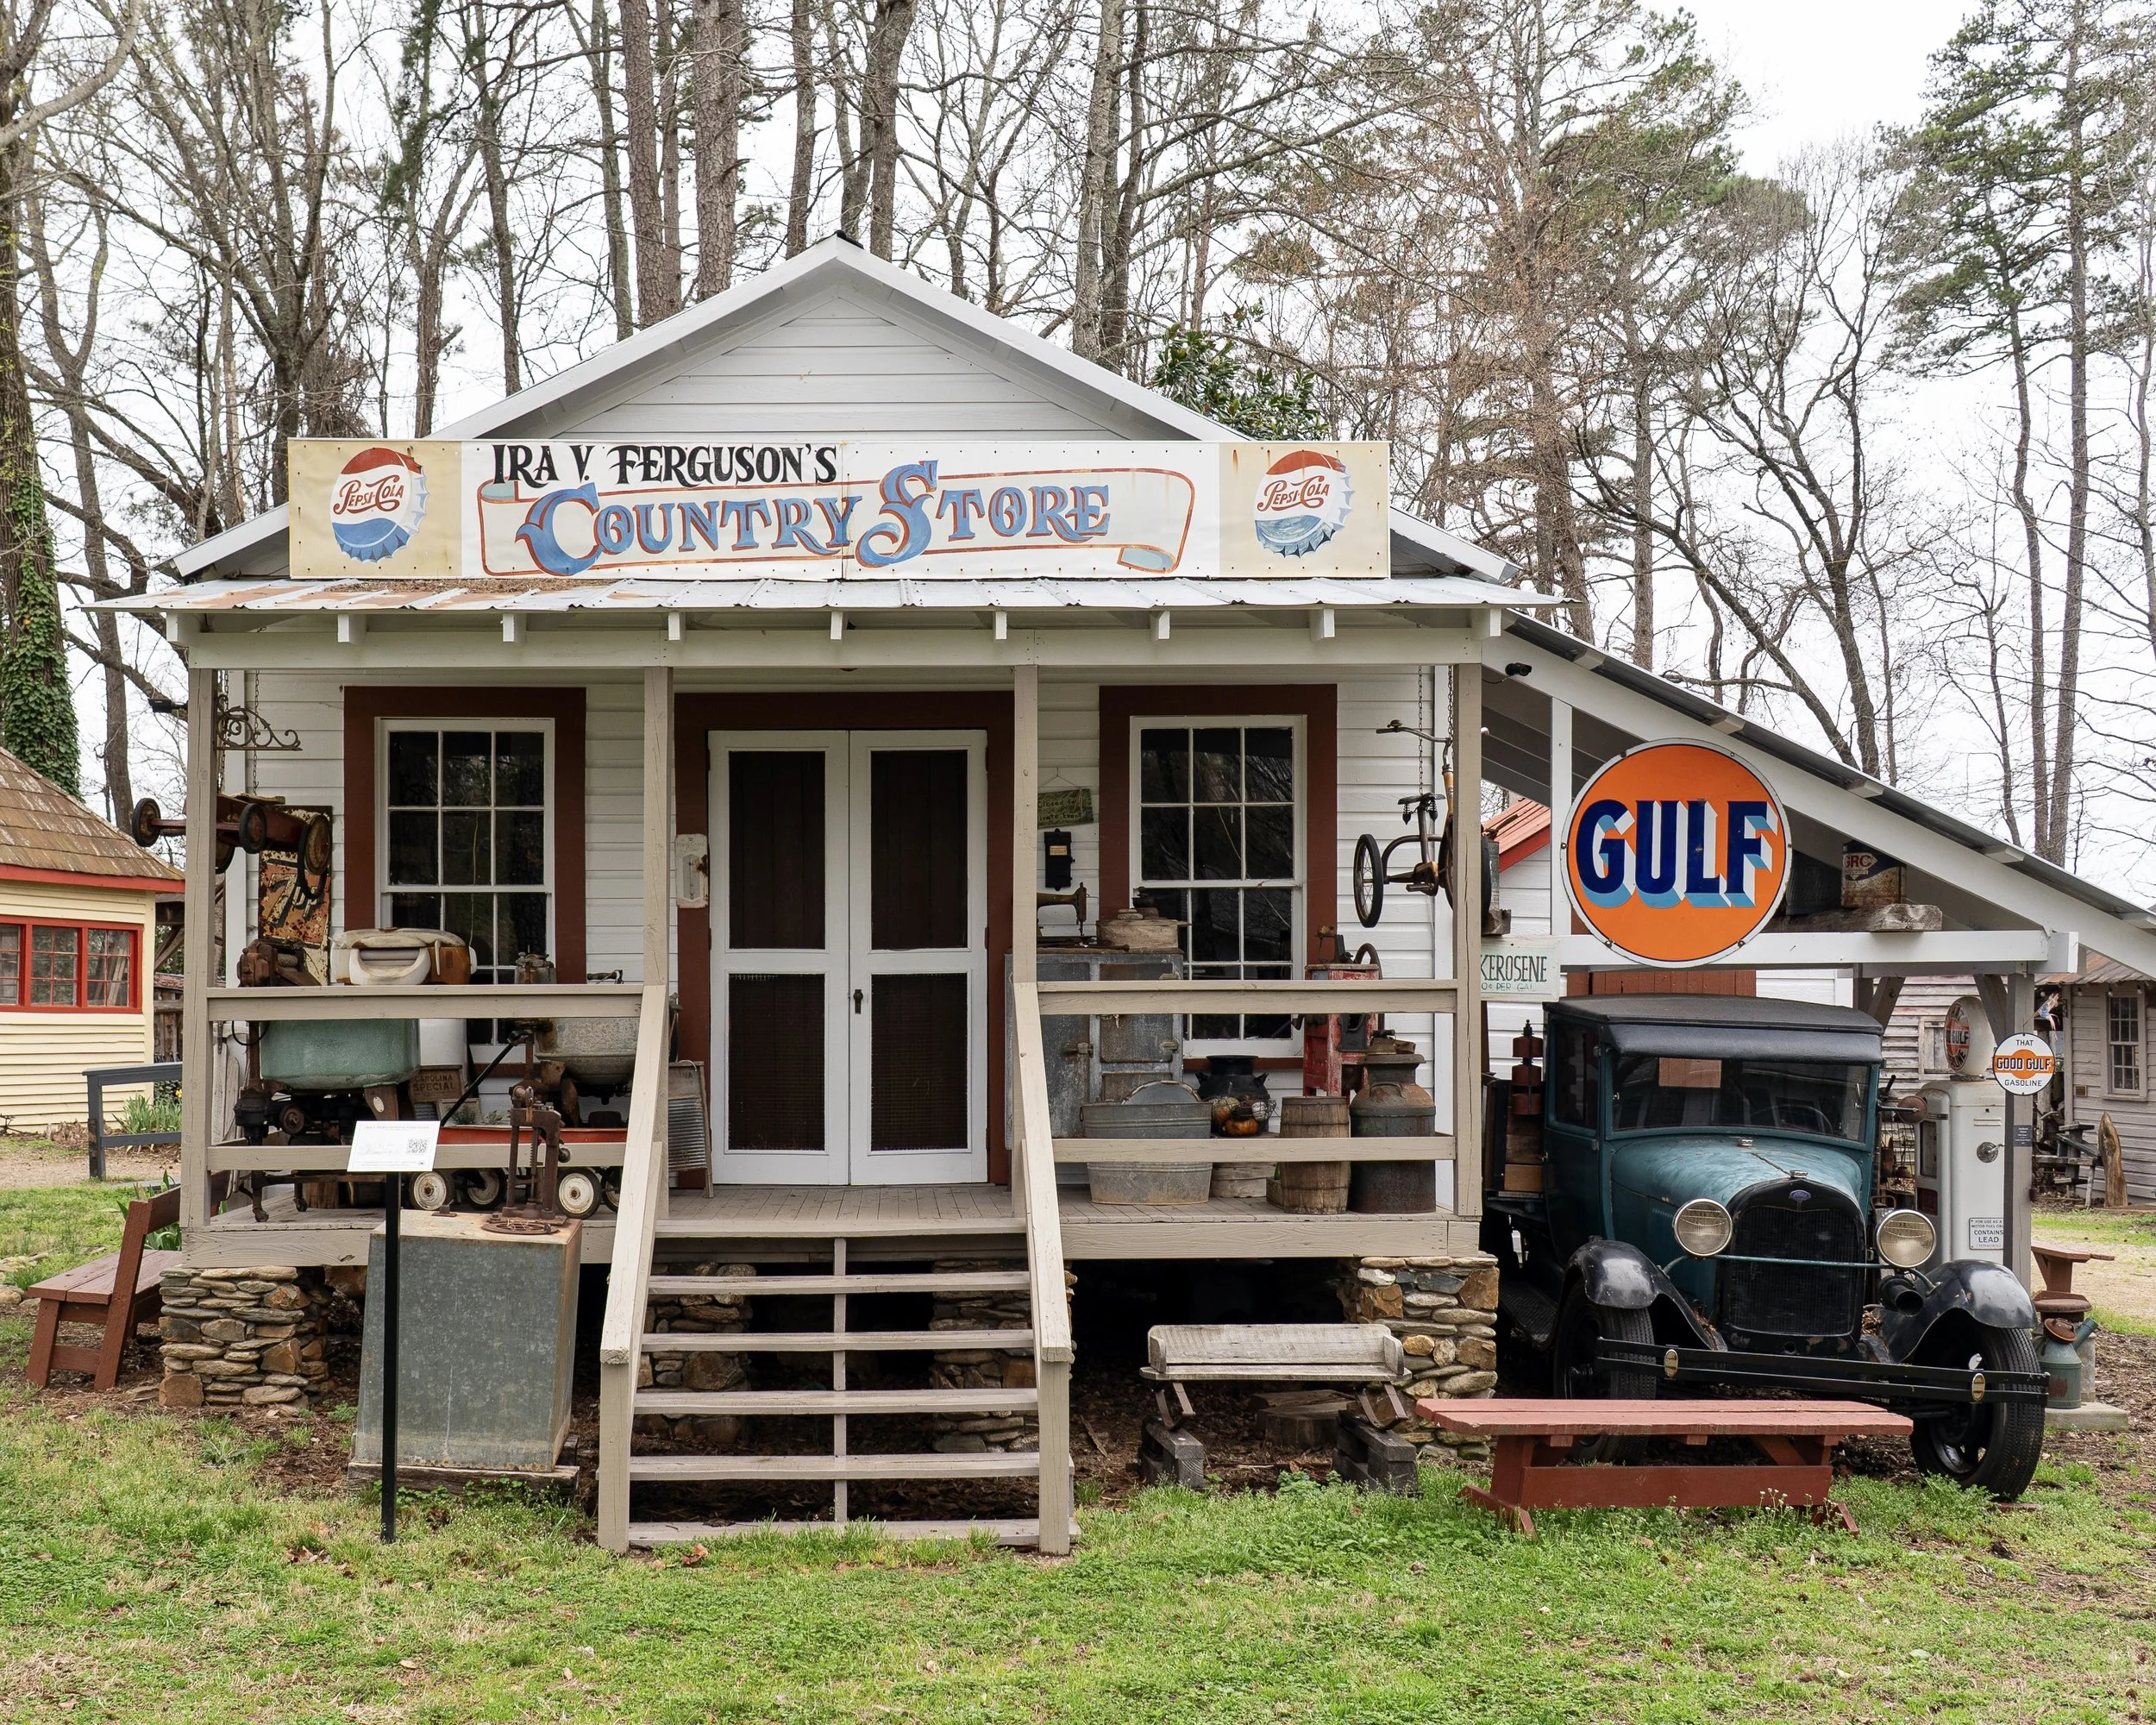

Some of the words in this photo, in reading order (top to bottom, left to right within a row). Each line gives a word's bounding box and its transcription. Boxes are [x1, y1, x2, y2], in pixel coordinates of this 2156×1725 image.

[492, 444, 559, 488] IRA
[571, 444, 590, 481] V.
[606, 442, 837, 488] FERGUSON'S
[515, 482, 862, 576] COUNTRY
[855, 460, 1111, 568] STORE
[1576, 799, 1778, 908] GULF
[415, 1074, 453, 1082] CAROLINA
[1996, 1057, 2024, 1070] GOOD
[2026, 1057, 2052, 1070] GULF
[413, 1082, 455, 1092] SPECIAL
